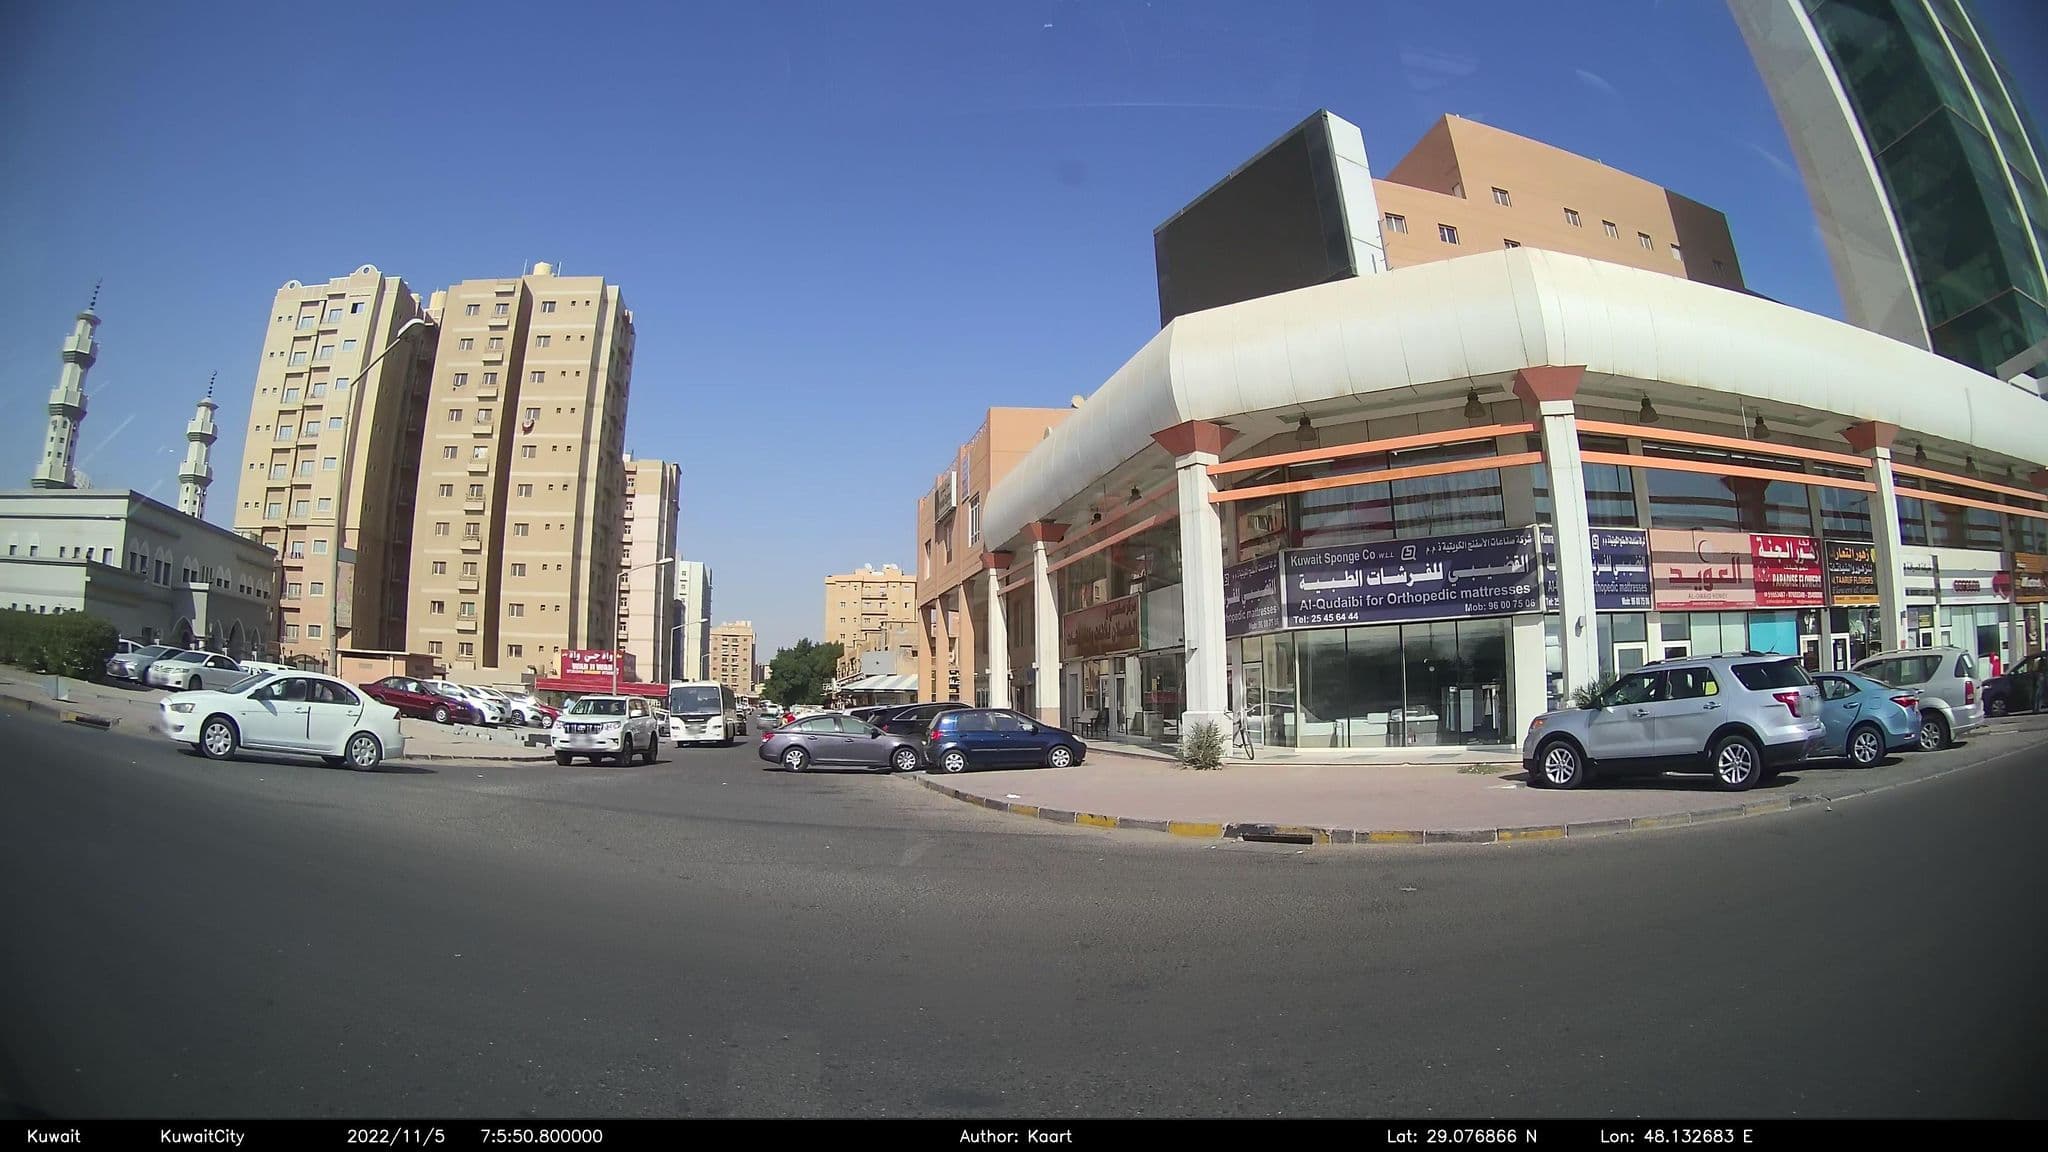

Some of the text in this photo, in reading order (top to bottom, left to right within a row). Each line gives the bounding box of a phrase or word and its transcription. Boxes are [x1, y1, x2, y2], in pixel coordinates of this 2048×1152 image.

[1291, 554, 1322, 567] Kuwait
[1324, 552, 1360, 565] Sponge
[1756, 536, 1794, 562] الجنة
[1299, 569, 1363, 594] الطبية
[1367, 562, 1443, 587] للفرشات
[1448, 554, 1529, 586] القضيبي
[1668, 555, 1743, 592] العويد
[1300, 596, 1363, 611] Al-Qudaibi
[1366, 594, 1384, 607] for
[1387, 588, 1457, 605] Orthopedic
[1460, 584, 1531, 599] mattresses
[1465, 602, 1487, 612] Mob:
[1500, 600, 1511, 609] 00
[1512, 599, 1523, 608] 75
[1292, 616, 1309, 624] Tel:
[1311, 614, 1322, 623] 25
[1323, 613, 1334, 622] 45
[1335, 613, 1346, 621] 64
